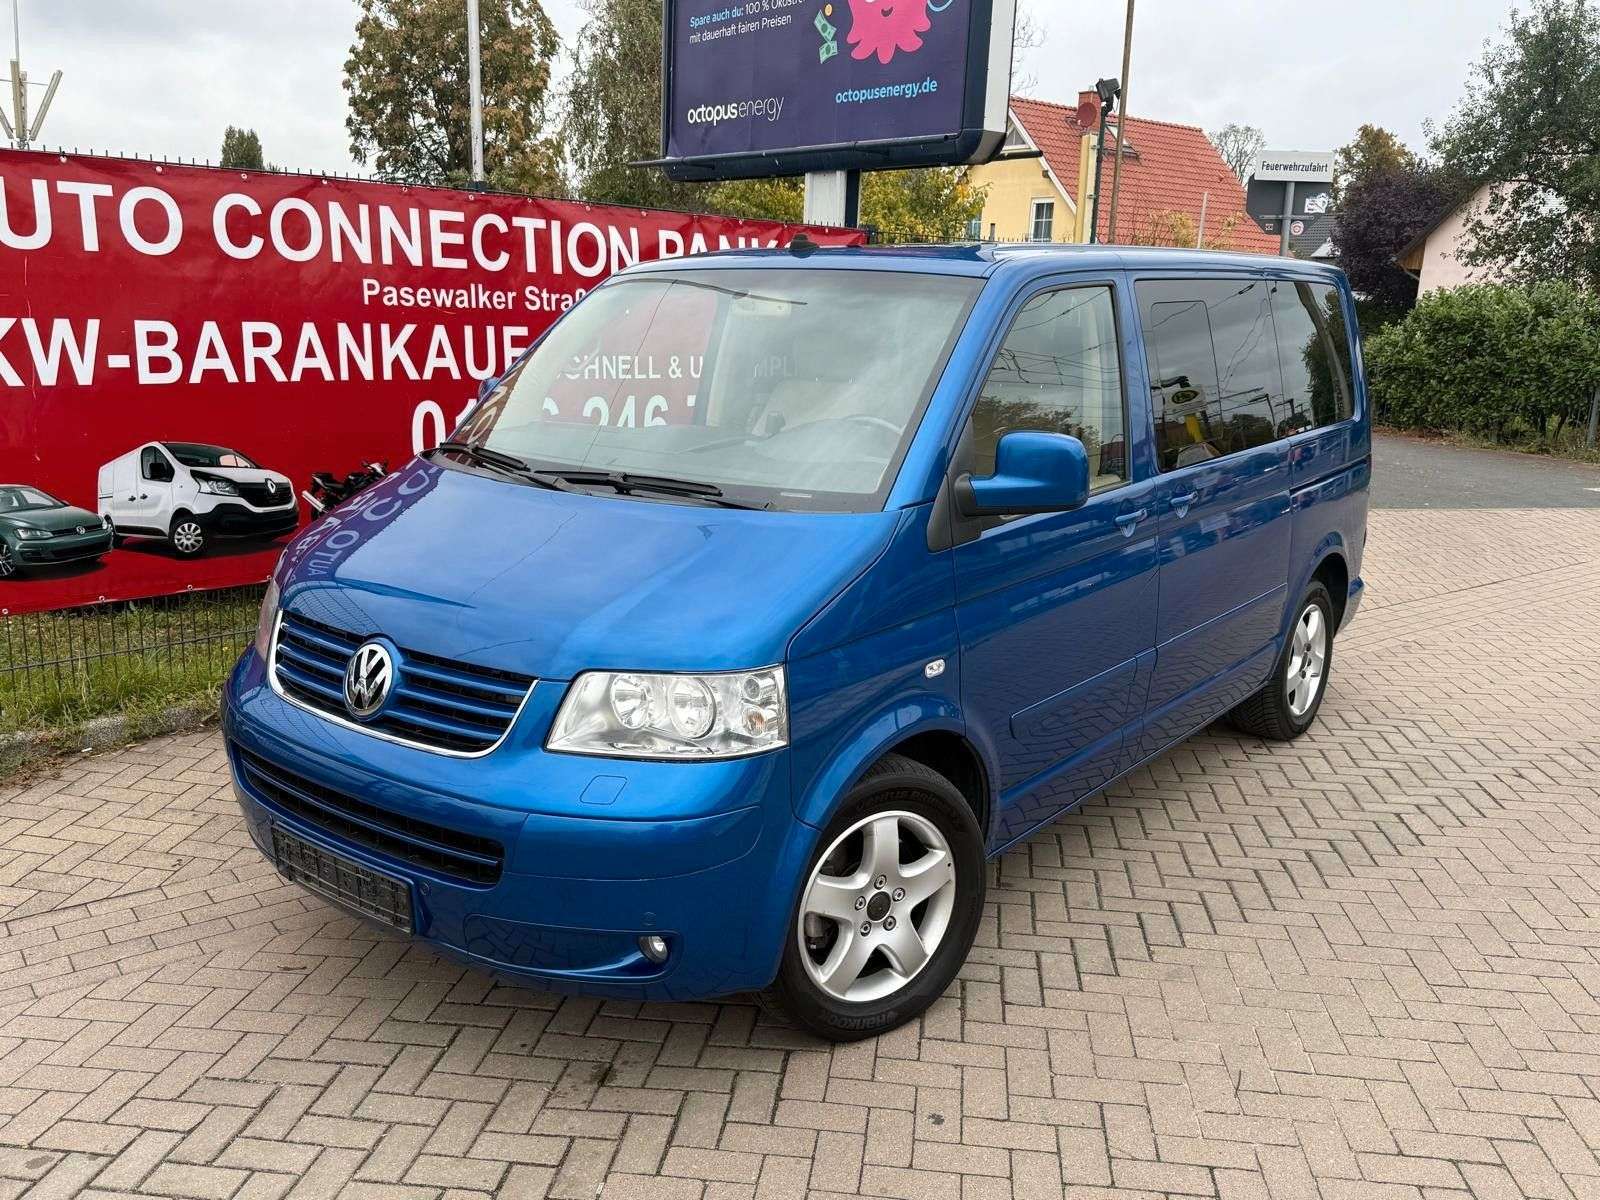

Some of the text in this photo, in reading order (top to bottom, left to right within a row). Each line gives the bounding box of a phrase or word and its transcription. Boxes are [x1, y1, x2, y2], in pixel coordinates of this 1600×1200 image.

[689, 14, 792, 44] mit dauerhaft fairen Preisen
[690, 16, 711, 29] Spare
[712, 9, 730, 23] auch
[731, 6, 744, 18] du:
[745, 1, 760, 15] 100
[835, 77, 938, 104] octopusenergy.de
[1261, 161, 1328, 173] Feuerwehrzufahrt
[212, 192, 640, 278] CONNECTION
[363, 278, 517, 311] Pasewalker
[668, 355, 683, 378] &
